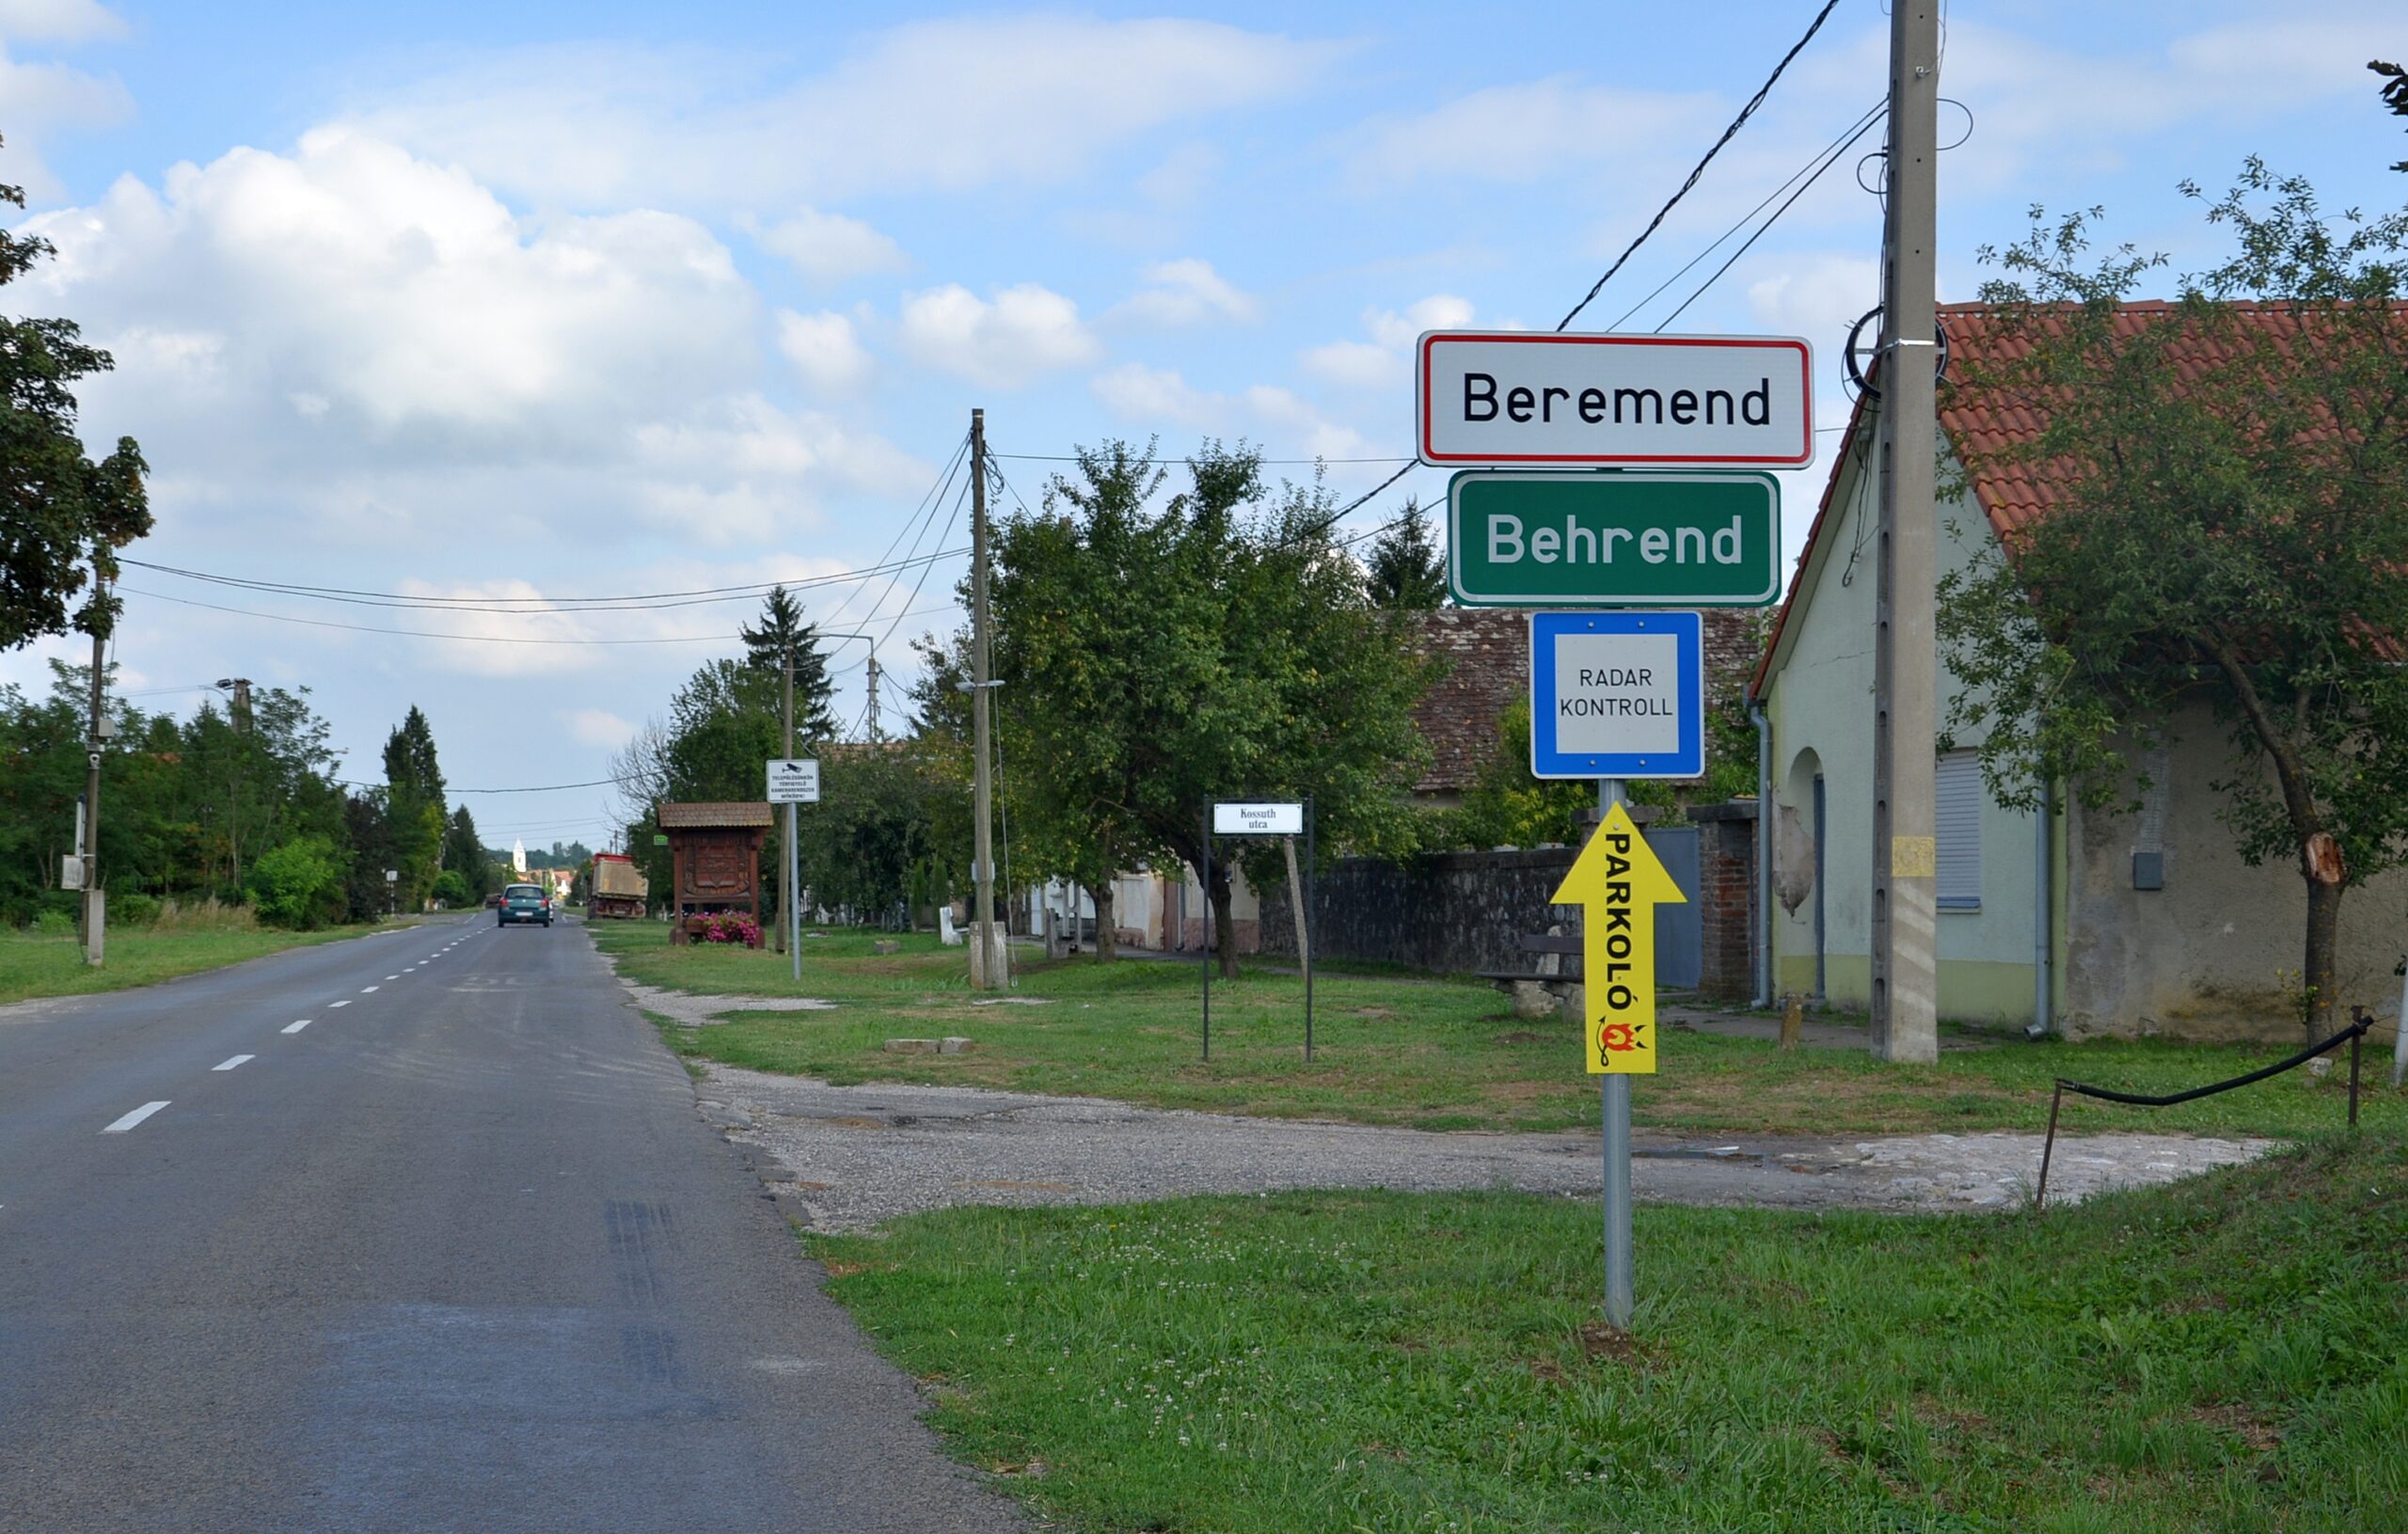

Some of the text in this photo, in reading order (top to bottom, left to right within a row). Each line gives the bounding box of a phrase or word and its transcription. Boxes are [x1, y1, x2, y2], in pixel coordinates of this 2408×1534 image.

[1464, 372, 1770, 426] Beremend
[1487, 514, 1743, 564] Behrend
[1579, 669, 1653, 687] RADAR
[1560, 698, 1673, 717] KONTROLL
[1241, 808, 1276, 818] Kossuth
[1248, 820, 1268, 829] utca
[1606, 833, 1639, 1010] PARKOLÓ
